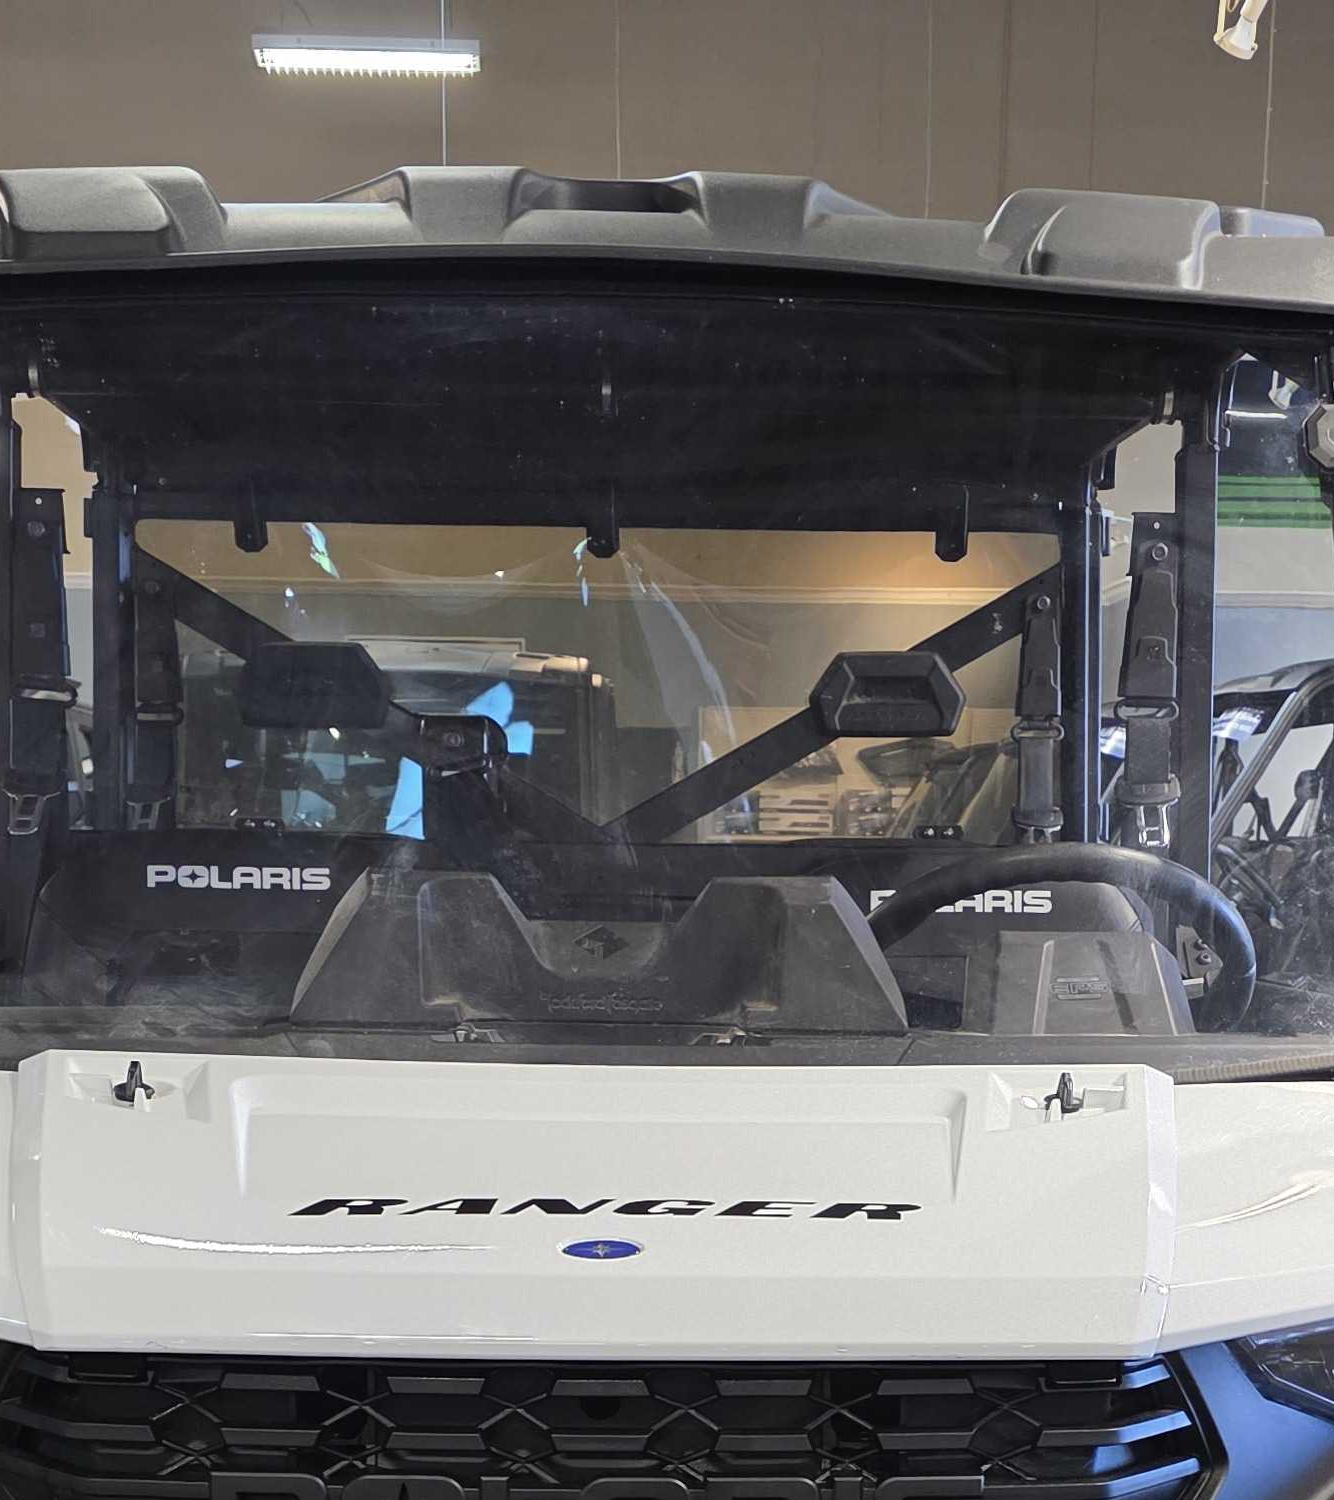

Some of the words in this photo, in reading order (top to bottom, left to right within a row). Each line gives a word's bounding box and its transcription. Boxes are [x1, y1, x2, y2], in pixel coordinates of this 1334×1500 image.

[146, 865, 331, 891] POLARIS
[870, 889, 1053, 913] PARIS
[287, 1197, 922, 1221] RANGER
